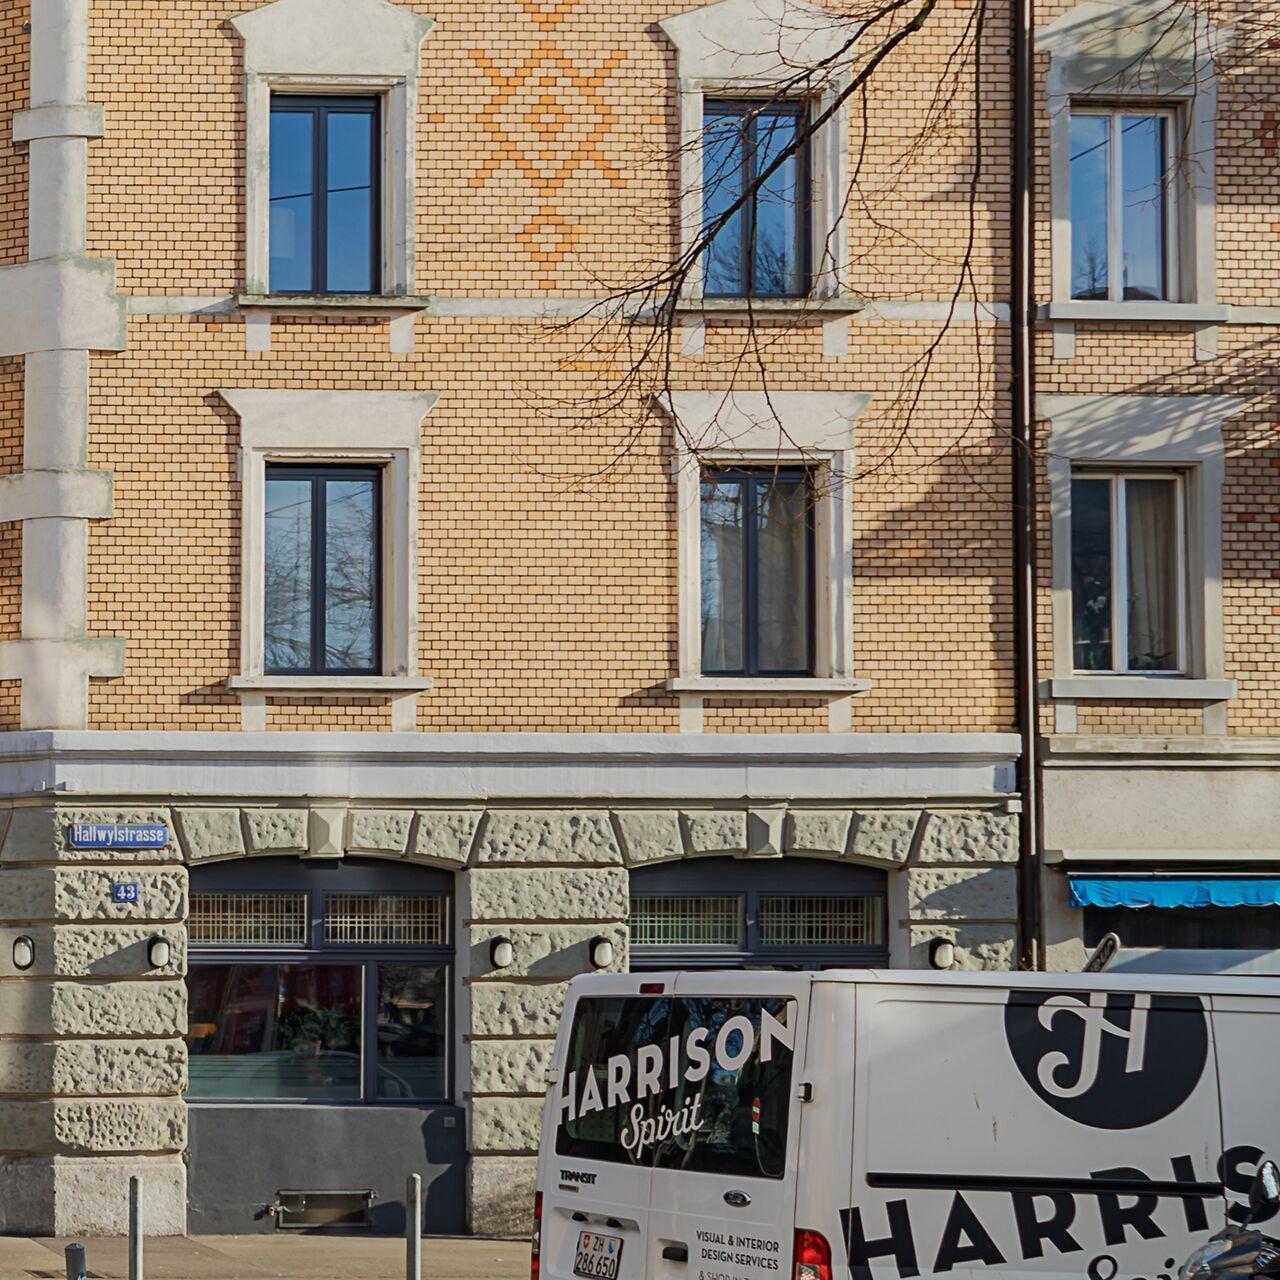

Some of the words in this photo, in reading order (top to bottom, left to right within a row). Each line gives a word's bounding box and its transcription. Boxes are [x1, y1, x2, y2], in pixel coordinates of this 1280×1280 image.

[73, 825, 164, 846] Hallwylstrasse
[116, 884, 136, 900] 43
[559, 999, 797, 1126] HARRISON
[620, 1092, 705, 1159] Spirit
[560, 1169, 597, 1184] TRANSIT
[592, 1236, 605, 1253] ZH
[696, 1230, 726, 1245] VISUAL
[727, 1235, 734, 1246] &
[736, 1236, 780, 1253] INTERIOR
[576, 1251, 595, 1273] 286
[595, 1255, 616, 1277] 650
[701, 1248, 733, 1263] DESIGN
[735, 1253, 779, 1271] SERVICES
